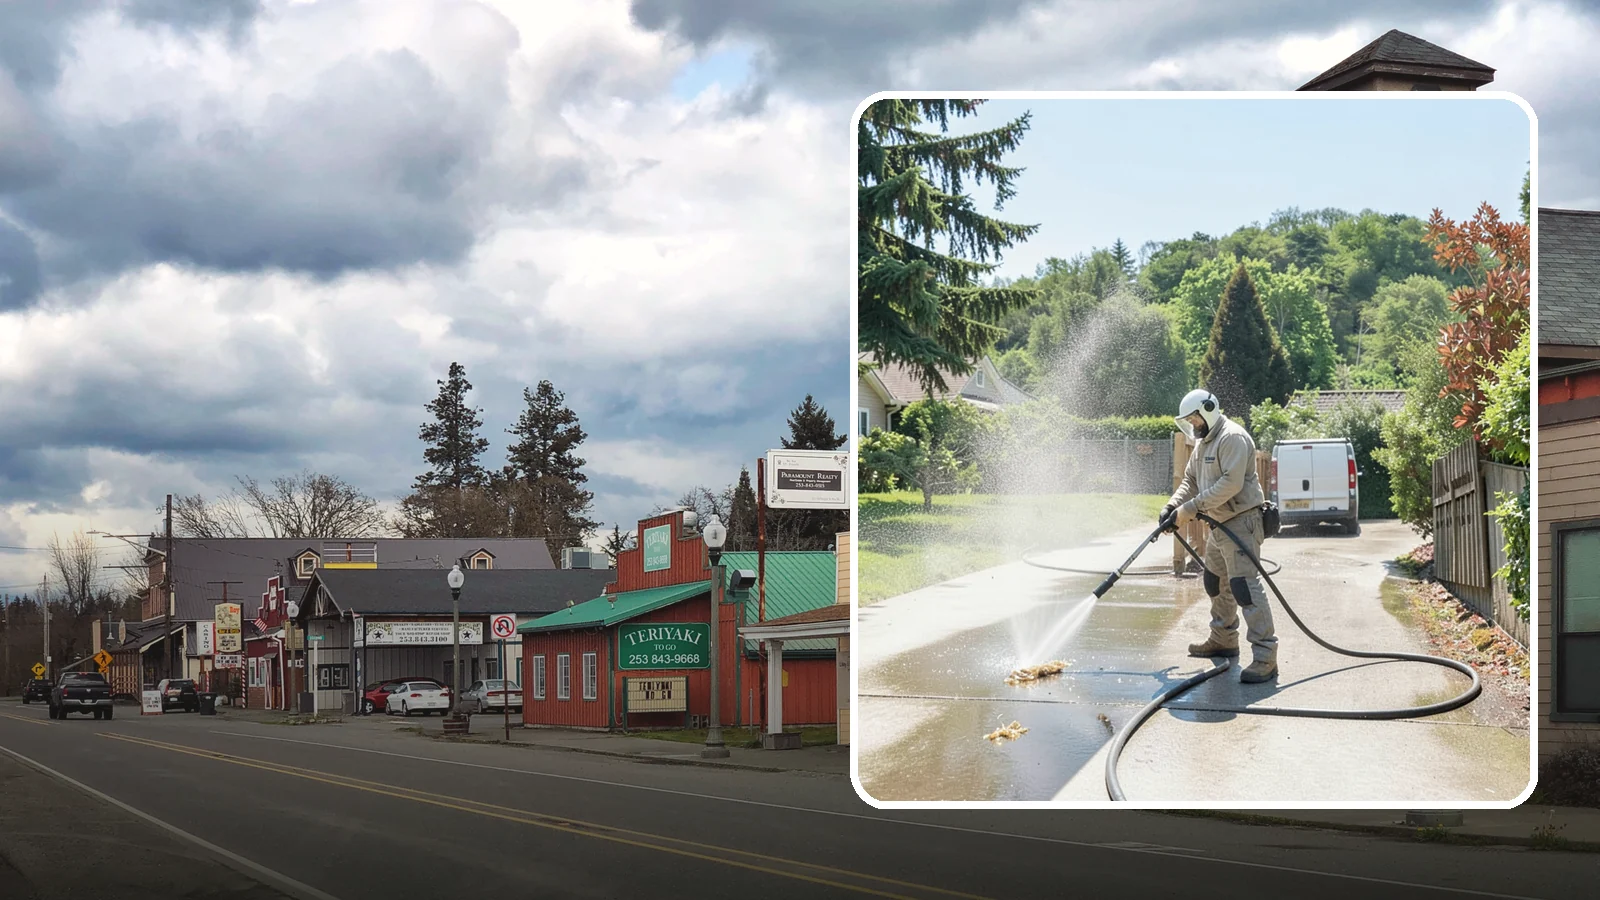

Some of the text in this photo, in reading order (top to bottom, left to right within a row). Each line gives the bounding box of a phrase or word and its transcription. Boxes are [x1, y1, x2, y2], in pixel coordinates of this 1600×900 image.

[781, 471, 839, 480] PARAMOUNT REALTY
[625, 628, 702, 646] TERIYAKI
[628, 653, 700, 665] 253 843-9668
